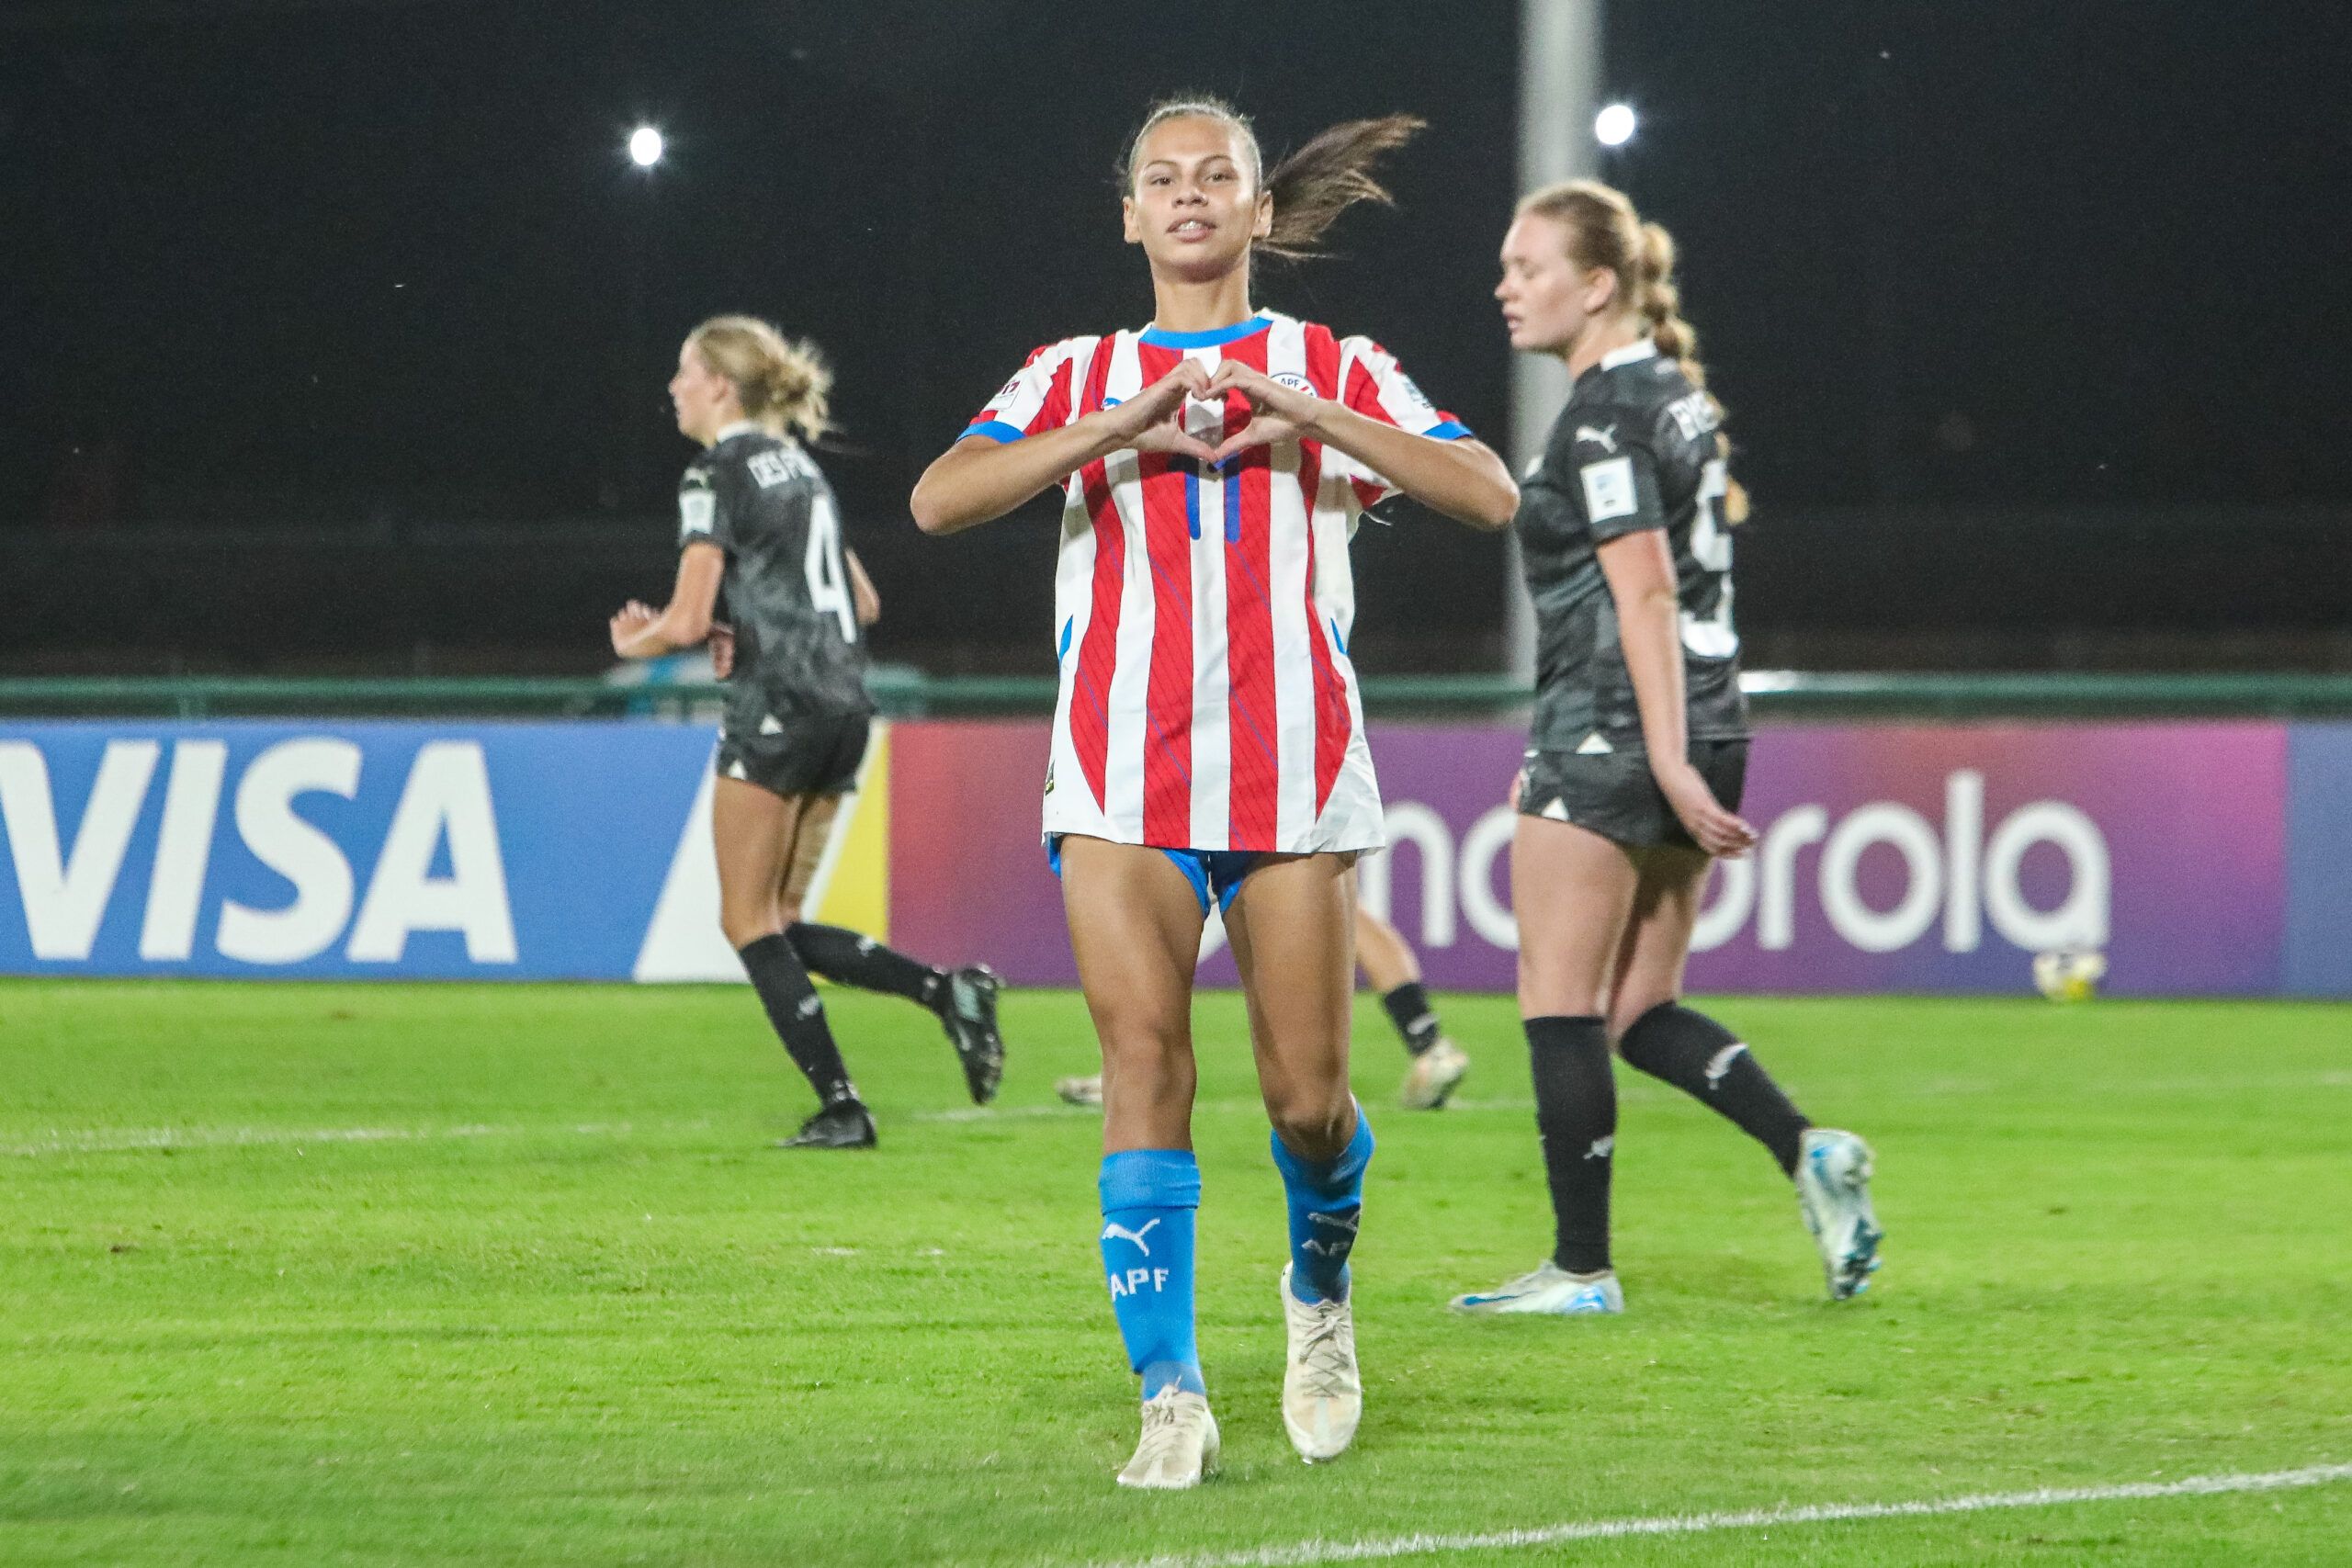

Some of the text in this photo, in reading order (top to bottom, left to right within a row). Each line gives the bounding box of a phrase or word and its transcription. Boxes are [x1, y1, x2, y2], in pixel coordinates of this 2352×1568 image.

[1280, 378, 1300, 388] APF
[805, 493, 857, 644] 4
[0, 739, 517, 964] VISA
[1110, 1267, 1169, 1302] APF
